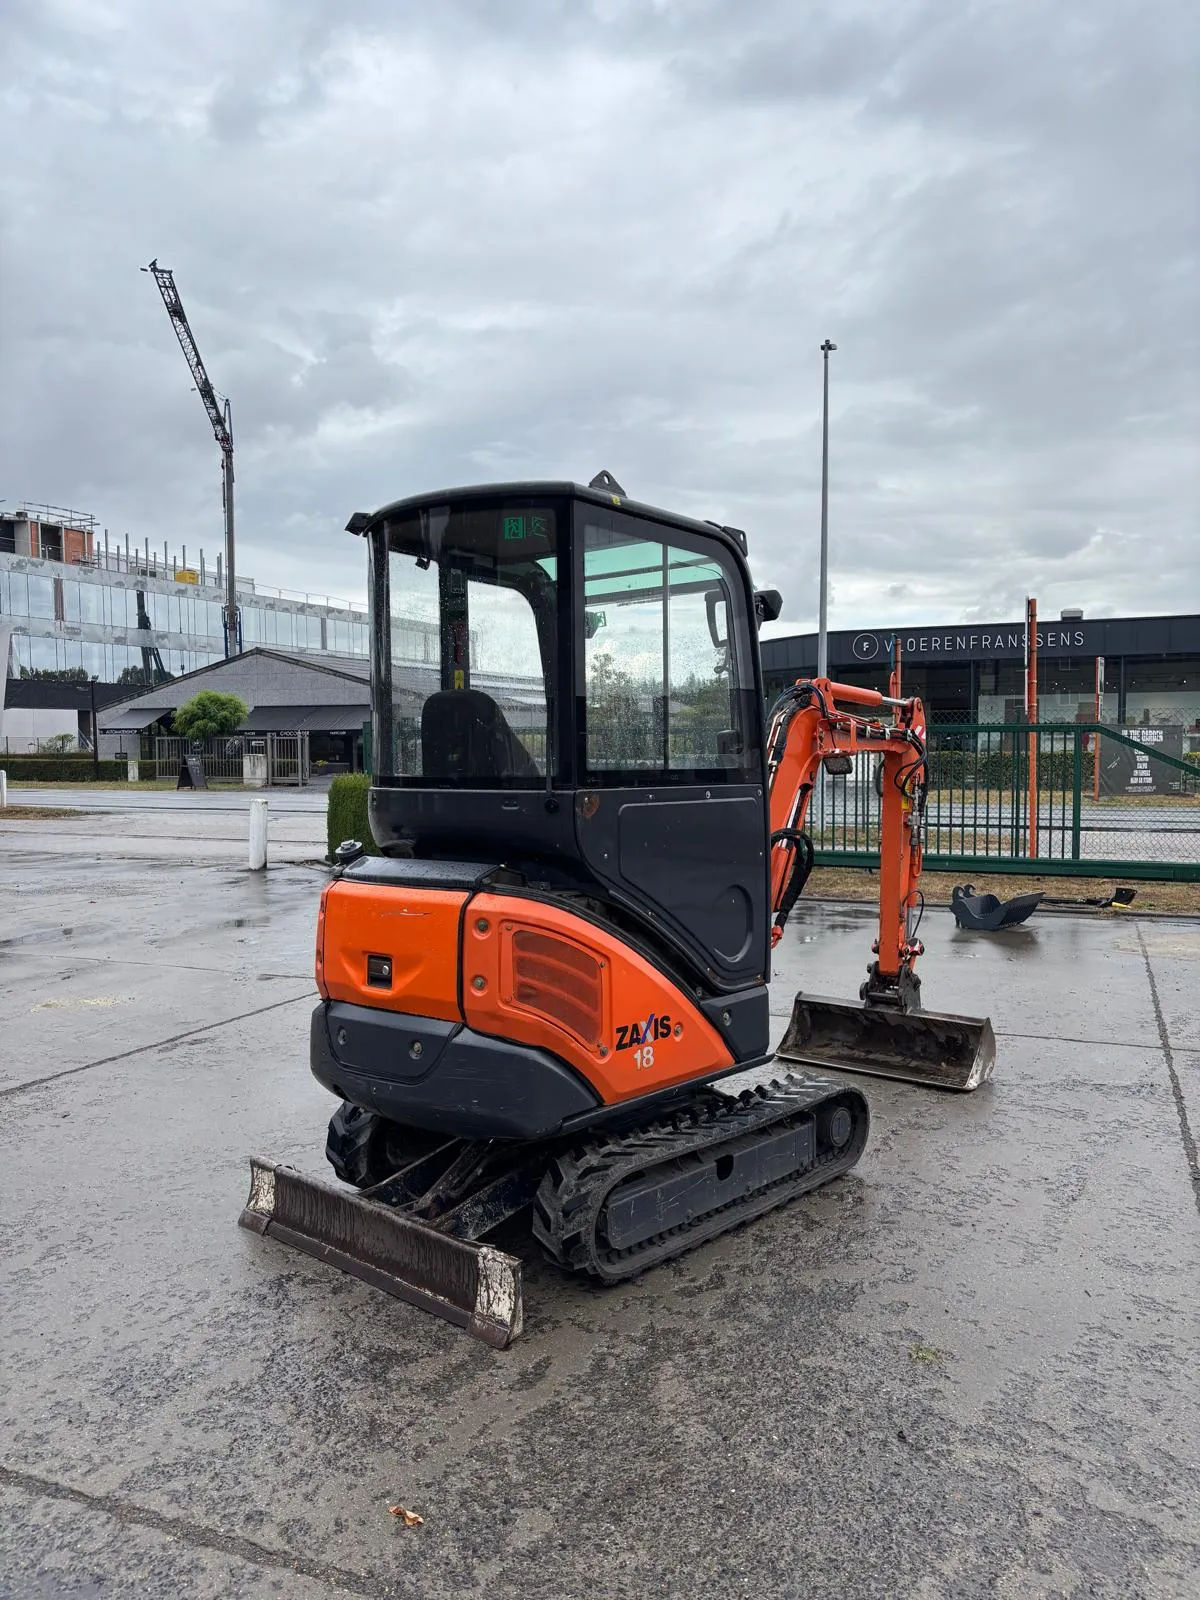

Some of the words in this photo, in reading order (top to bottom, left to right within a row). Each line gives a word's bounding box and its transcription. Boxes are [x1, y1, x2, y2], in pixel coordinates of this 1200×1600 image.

[884, 631, 1084, 653] VOERENFRANSSENS
[615, 1013, 672, 1051] ZAXIS
[633, 1045, 655, 1070] 18
